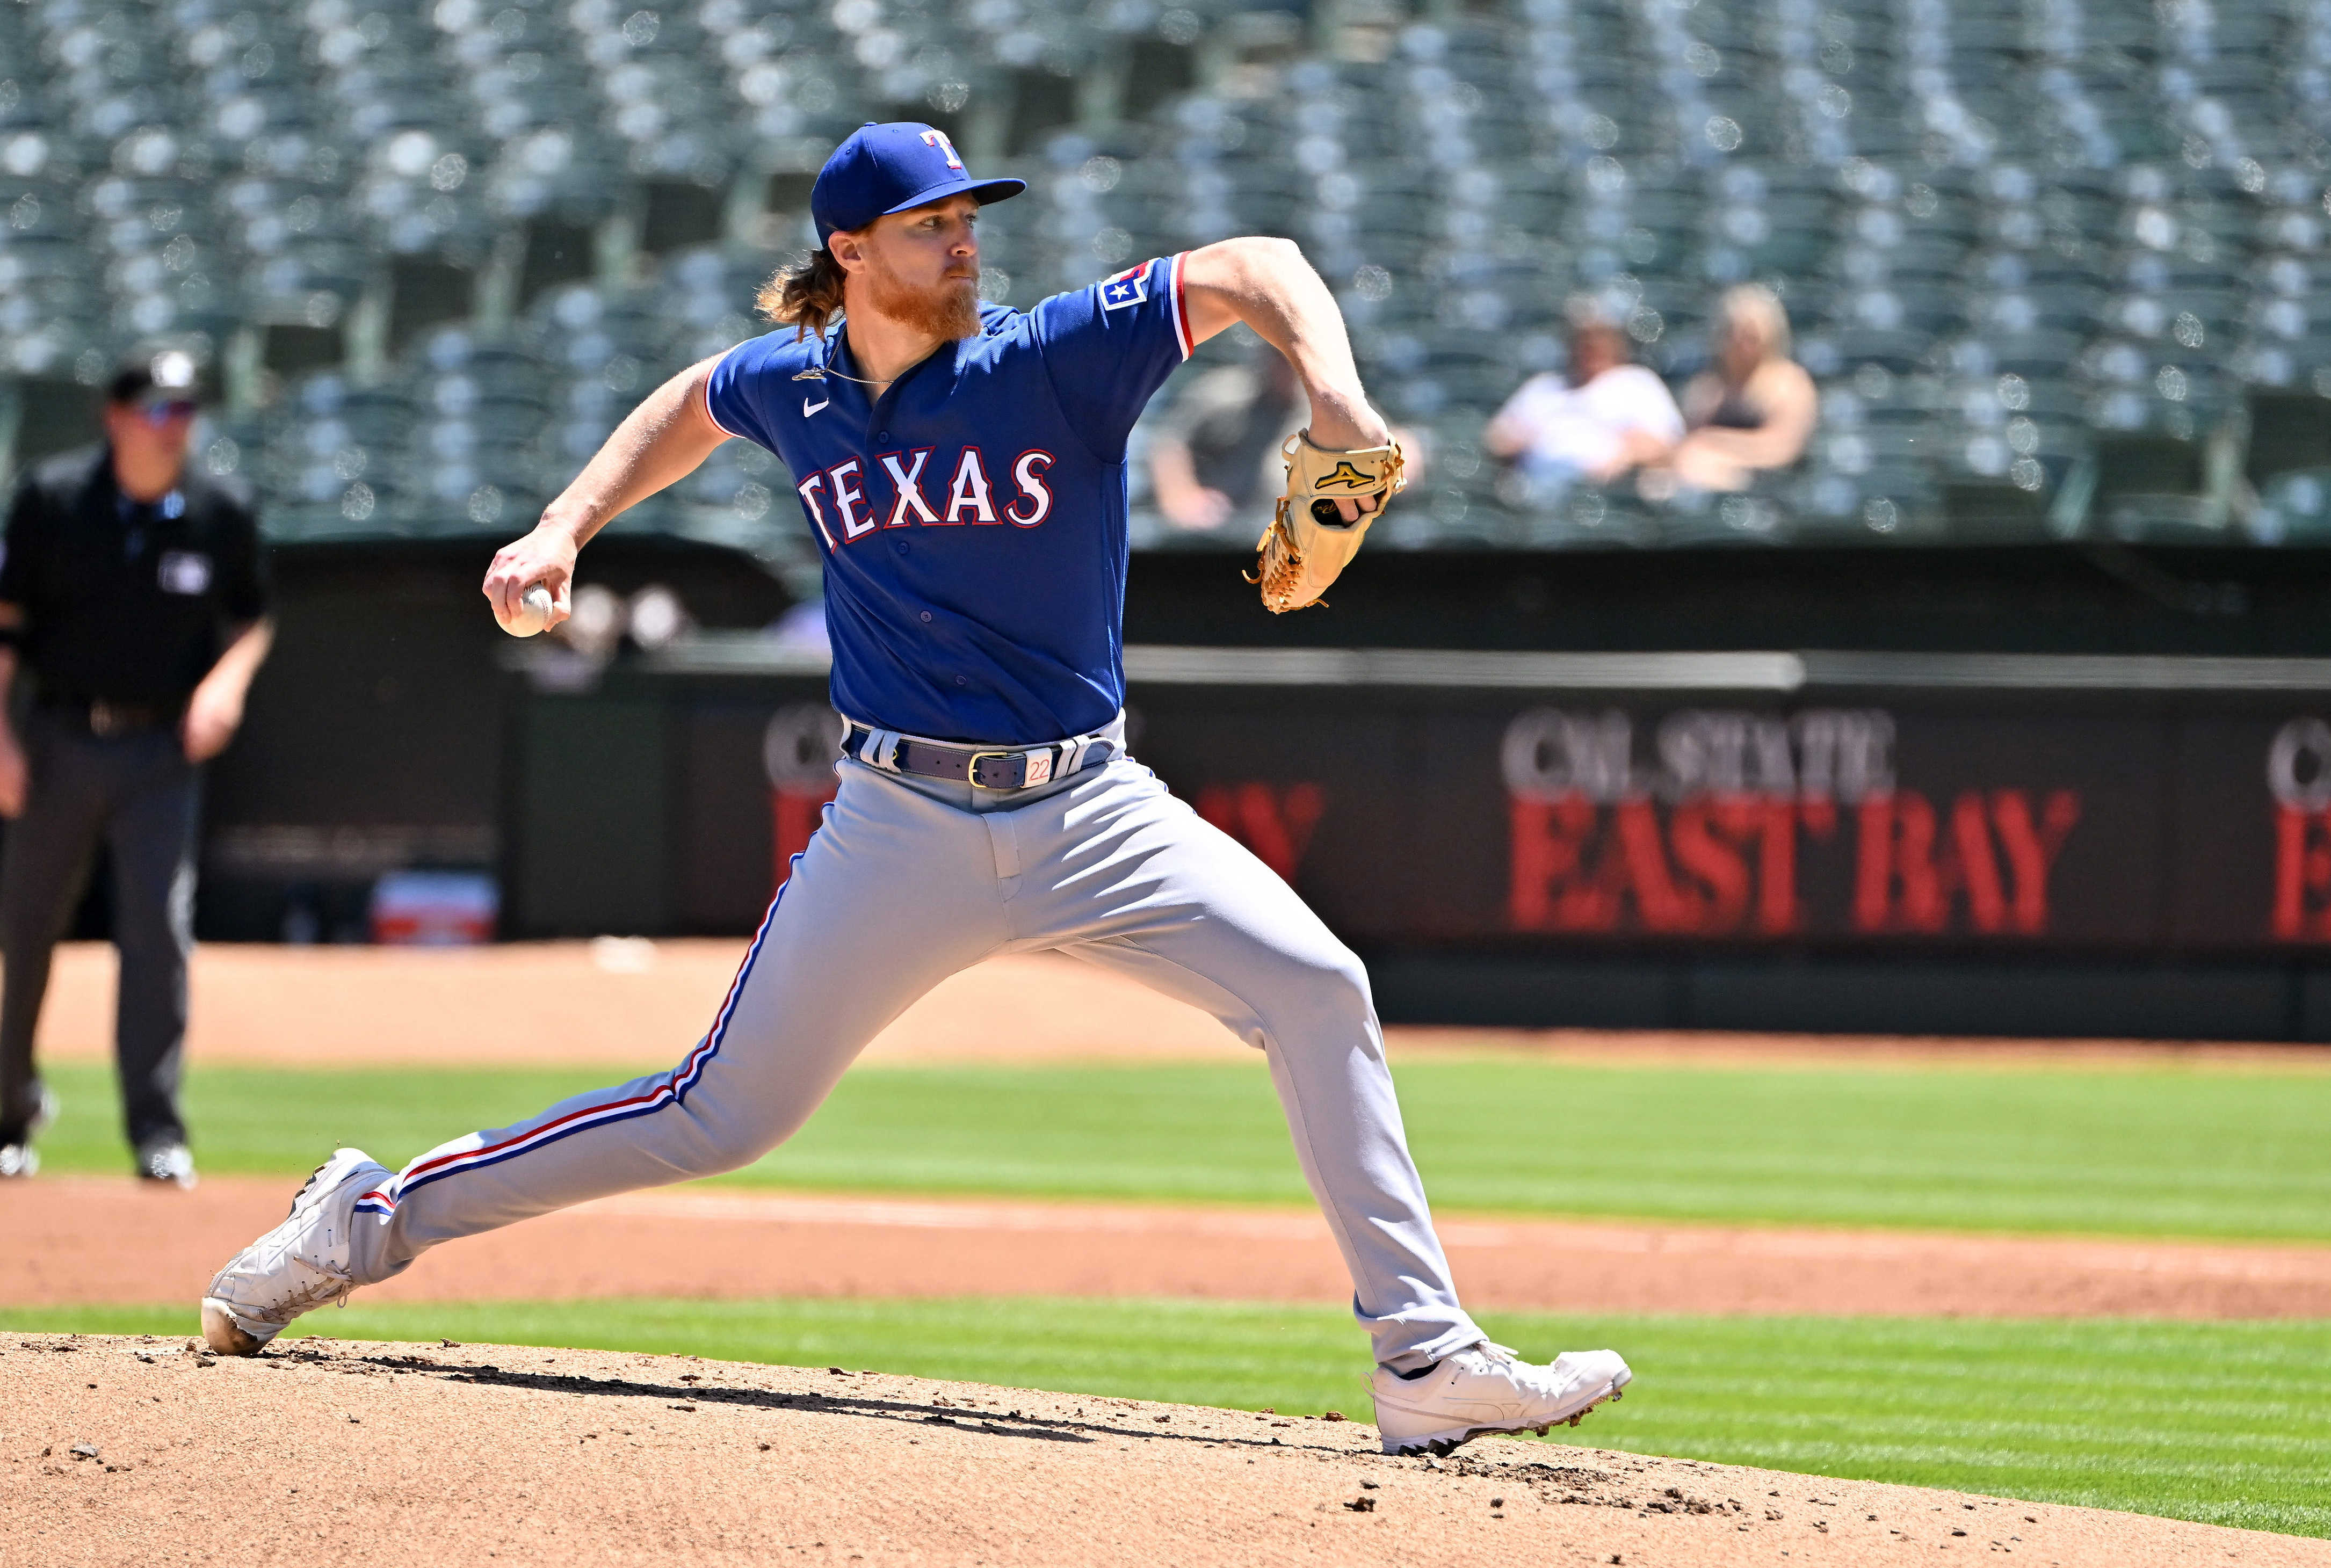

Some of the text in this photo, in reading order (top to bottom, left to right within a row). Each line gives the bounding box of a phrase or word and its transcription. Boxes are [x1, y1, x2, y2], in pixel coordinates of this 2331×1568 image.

[920, 130, 961, 169] T
[797, 445, 1056, 554] TEXAS
[1029, 759, 1049, 781] 22
[1510, 789, 2080, 934] EAST BAY
